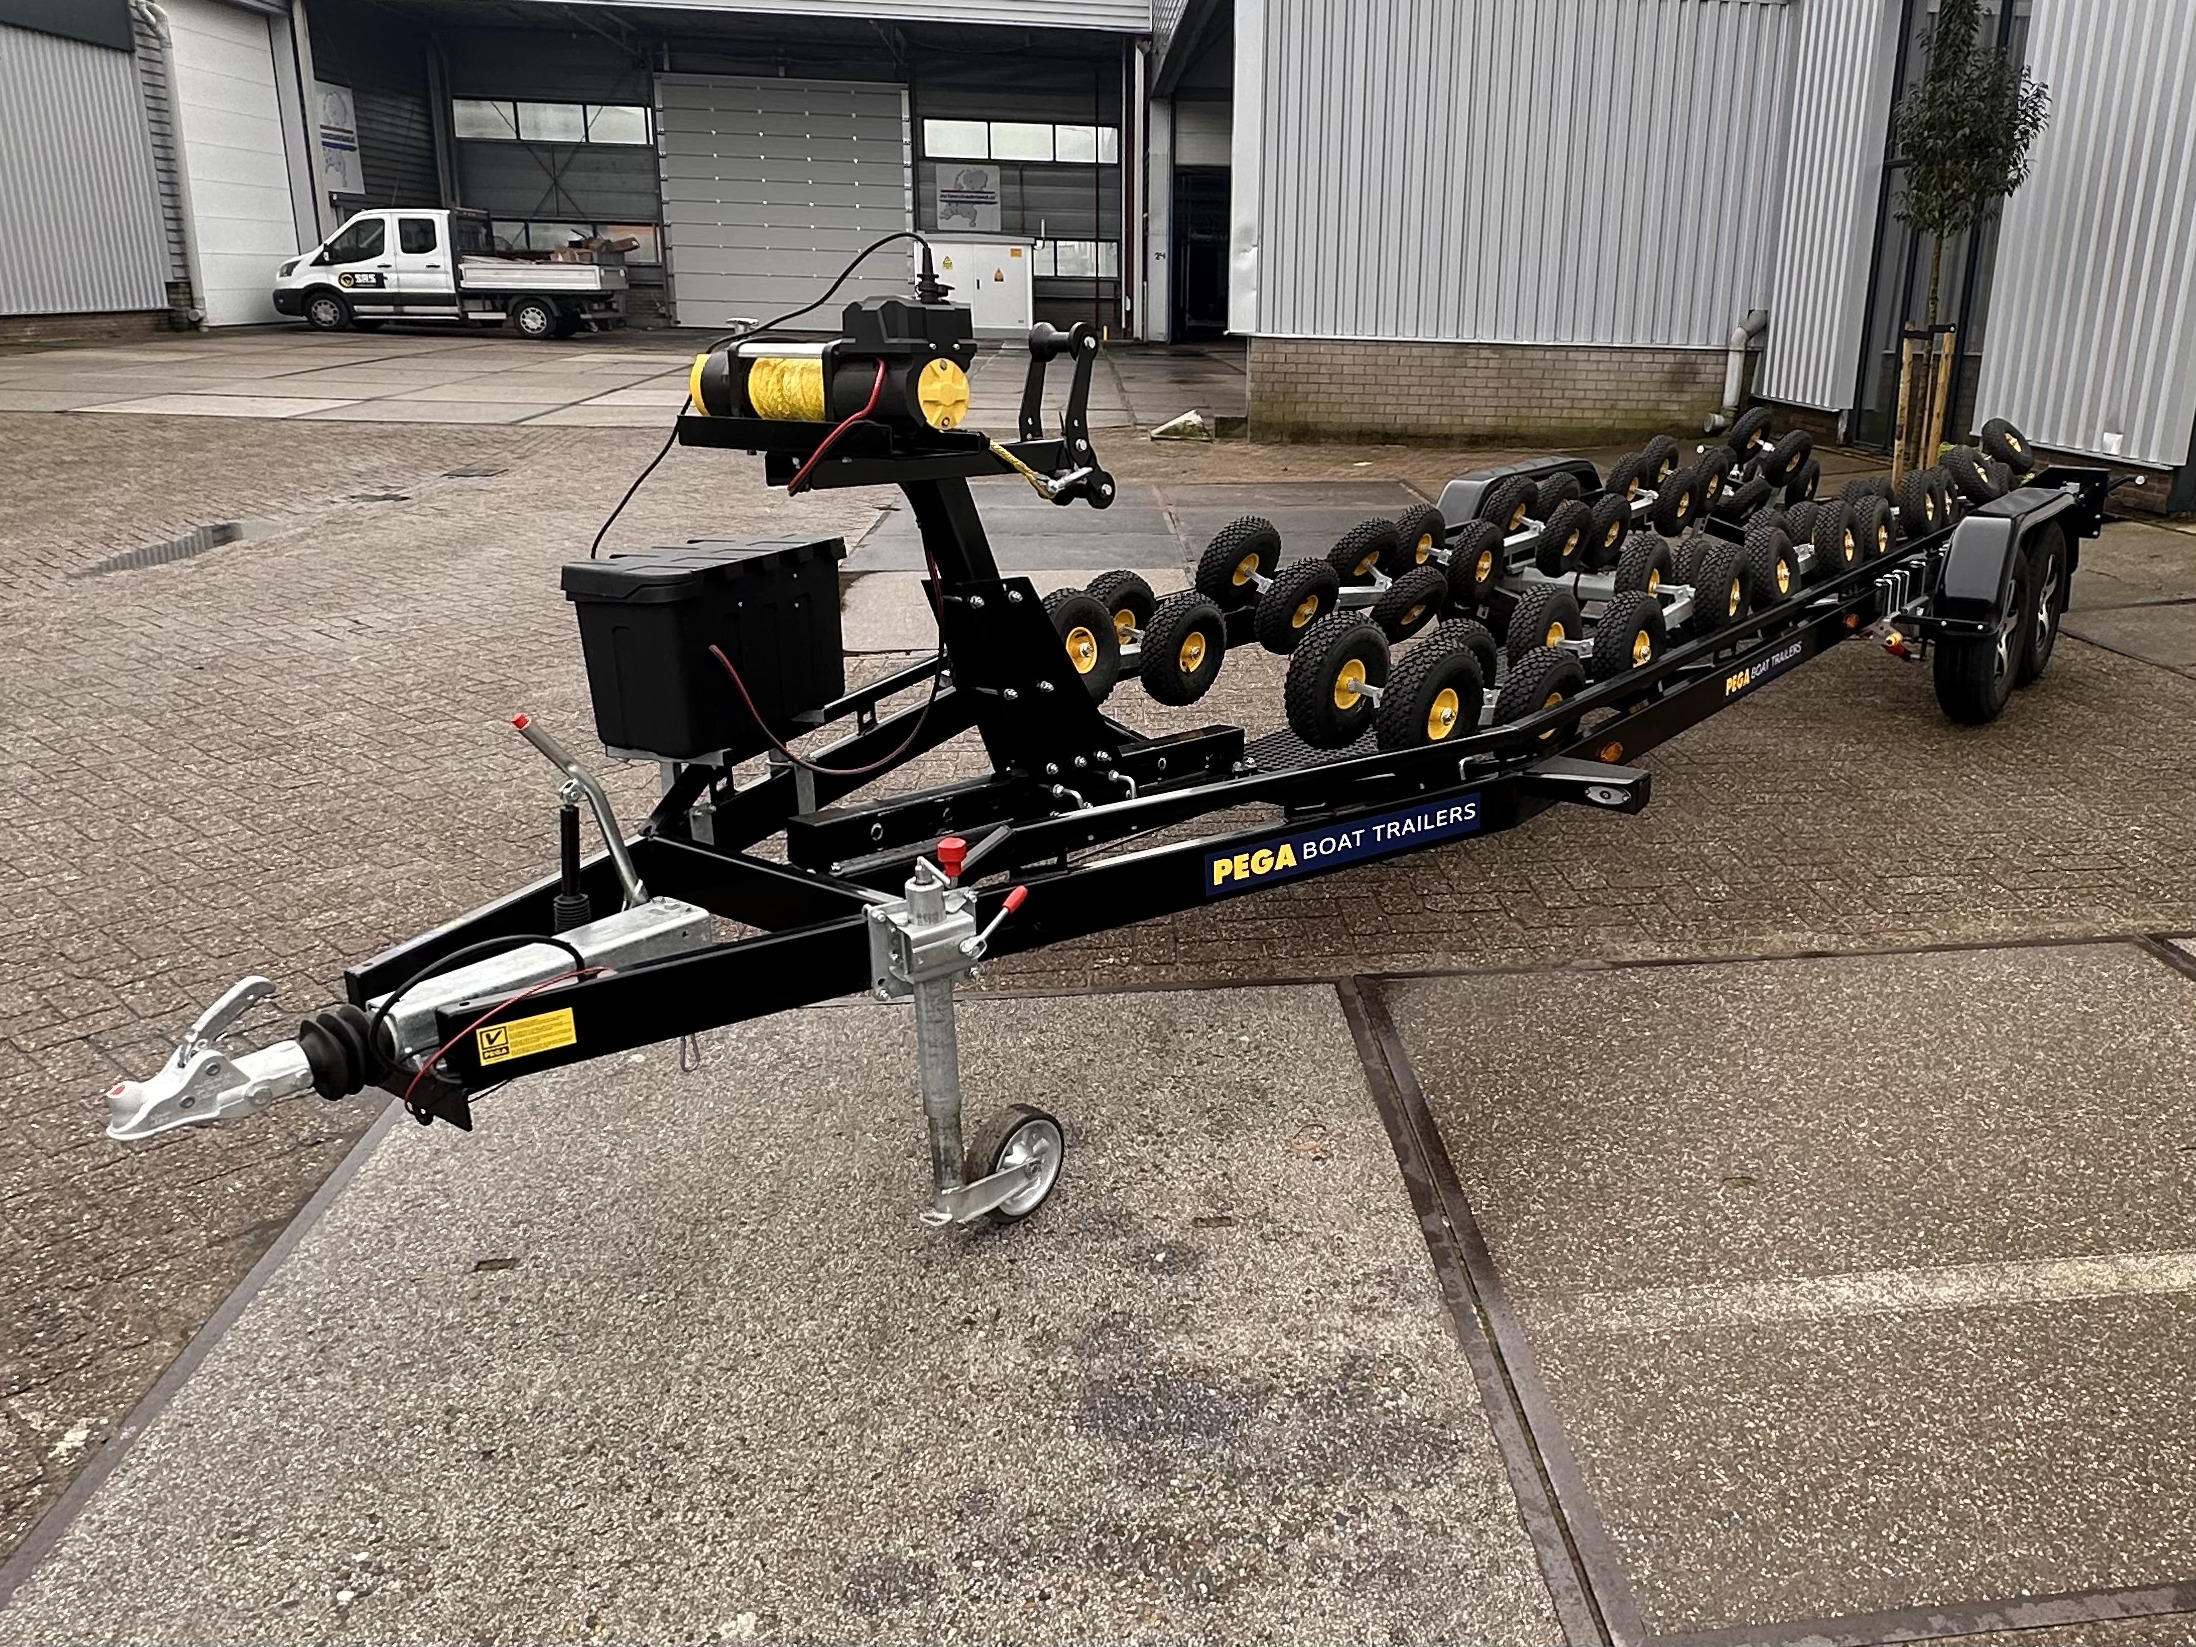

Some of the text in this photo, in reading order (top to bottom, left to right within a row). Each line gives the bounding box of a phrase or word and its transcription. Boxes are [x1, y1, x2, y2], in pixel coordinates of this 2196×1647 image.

[1725, 667, 1750, 696] PEGA
[1751, 658, 1770, 680] BOAT
[1213, 802, 1477, 886] PEGA BOAT TRAILERS
[483, 1047, 509, 1059] PEGA
